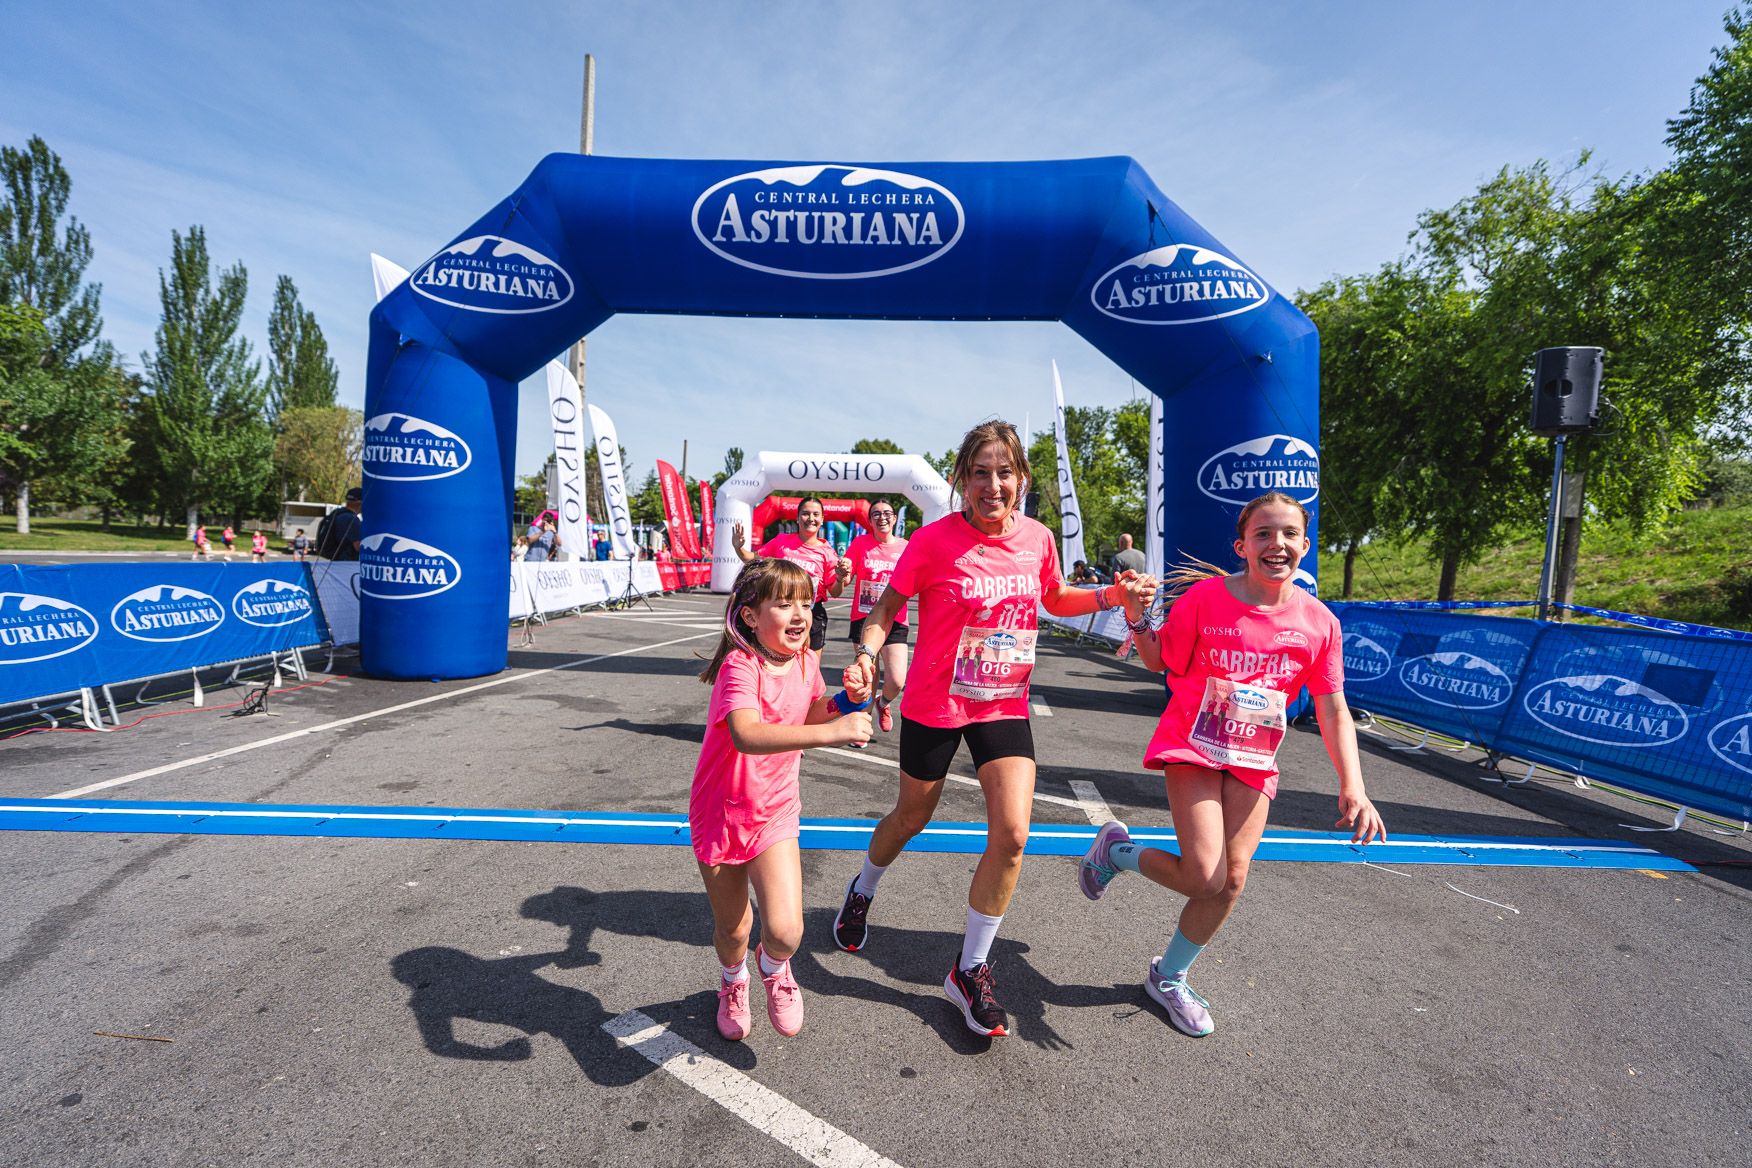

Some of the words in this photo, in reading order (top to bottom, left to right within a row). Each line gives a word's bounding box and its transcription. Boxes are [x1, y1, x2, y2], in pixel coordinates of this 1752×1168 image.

[755, 191, 839, 204] CENTRAL
[849, 193, 935, 205] LECHERA
[712, 193, 943, 245] ASTURIANA
[443, 258, 491, 269] CENTRAL
[496, 262, 555, 278] LECHERA
[415, 261, 561, 300] ASTURIANA
[1133, 269, 1194, 283] CENTRAL
[1199, 269, 1250, 280] LECHERA
[1105, 279, 1262, 309] ASTURIANA
[404, 437, 455, 448] LECHERA
[788, 459, 884, 481] OYSHO
[1233, 460, 1283, 468] CENTRAL
[395, 557, 445, 566] LECHERA
[537, 569, 573, 590] OYSHO
[28, 611, 80, 622] LECHERA
[124, 608, 220, 631] ASTURIANA
[0, 620, 91, 646] URIANA
[1203, 626, 1242, 637] OYSHO
[981, 661, 1011, 675] 016
[1406, 664, 1500, 702] ASTURIANA
[959, 688, 985, 697] OYSHO
[1233, 694, 1266, 707] ASTURIANA
[1532, 689, 1669, 738] ASTURIANA
[1225, 719, 1257, 737] 016
[1199, 745, 1227, 758] OYSHO
[1242, 756, 1265, 765] Santander
